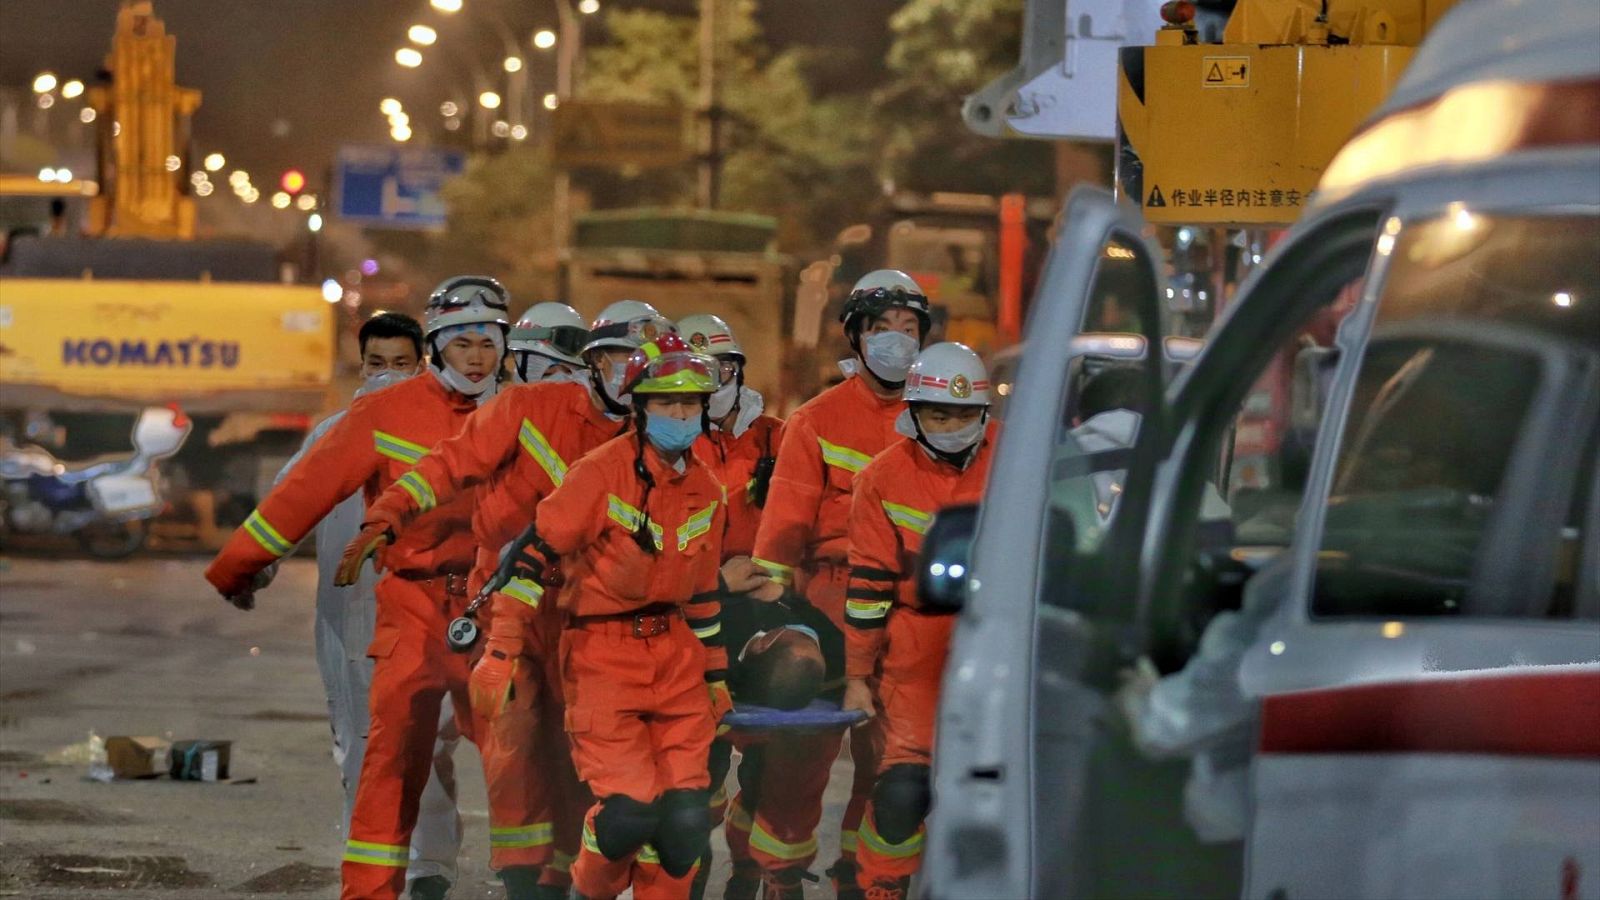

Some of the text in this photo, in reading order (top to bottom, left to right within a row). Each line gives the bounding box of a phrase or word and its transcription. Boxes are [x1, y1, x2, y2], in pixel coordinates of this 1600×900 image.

[1171, 188, 1313, 208] 作业半径内注意安
[62, 337, 241, 368] KOMATSU
